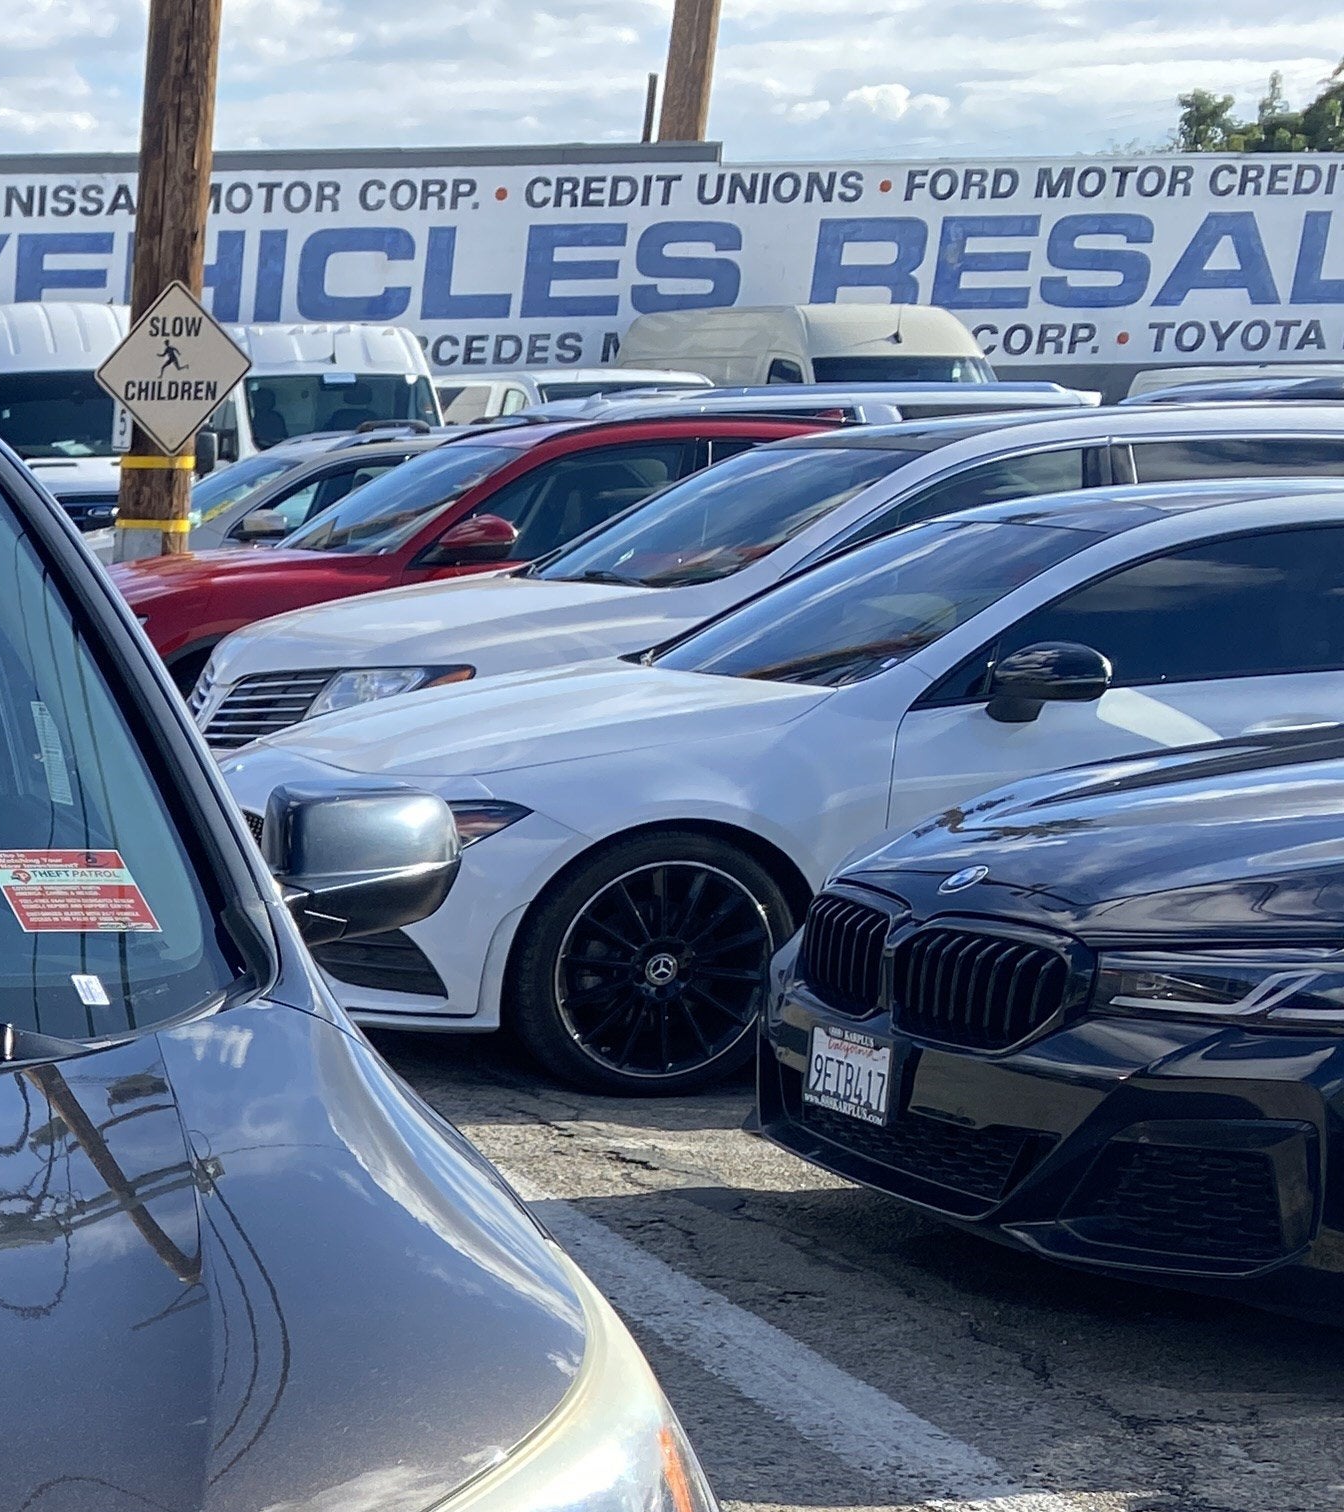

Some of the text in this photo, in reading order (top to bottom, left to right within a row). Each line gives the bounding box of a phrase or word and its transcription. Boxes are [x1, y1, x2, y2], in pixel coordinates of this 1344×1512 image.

[4, 183, 136, 218] NISSA
[359, 177, 480, 212] CORP.
[524, 173, 684, 208] CREDIT
[696, 170, 865, 206] UNIONS
[904, 167, 1020, 201] FORD
[1033, 165, 1195, 199] MOTOR
[1209, 163, 1344, 197] CREDI
[149, 316, 203, 338] SLOW
[420, 331, 584, 367] CEDES
[971, 322, 1100, 356] CORP.
[1149, 319, 1327, 353] TOYOTA
[124, 380, 218, 401] CHILDREN
